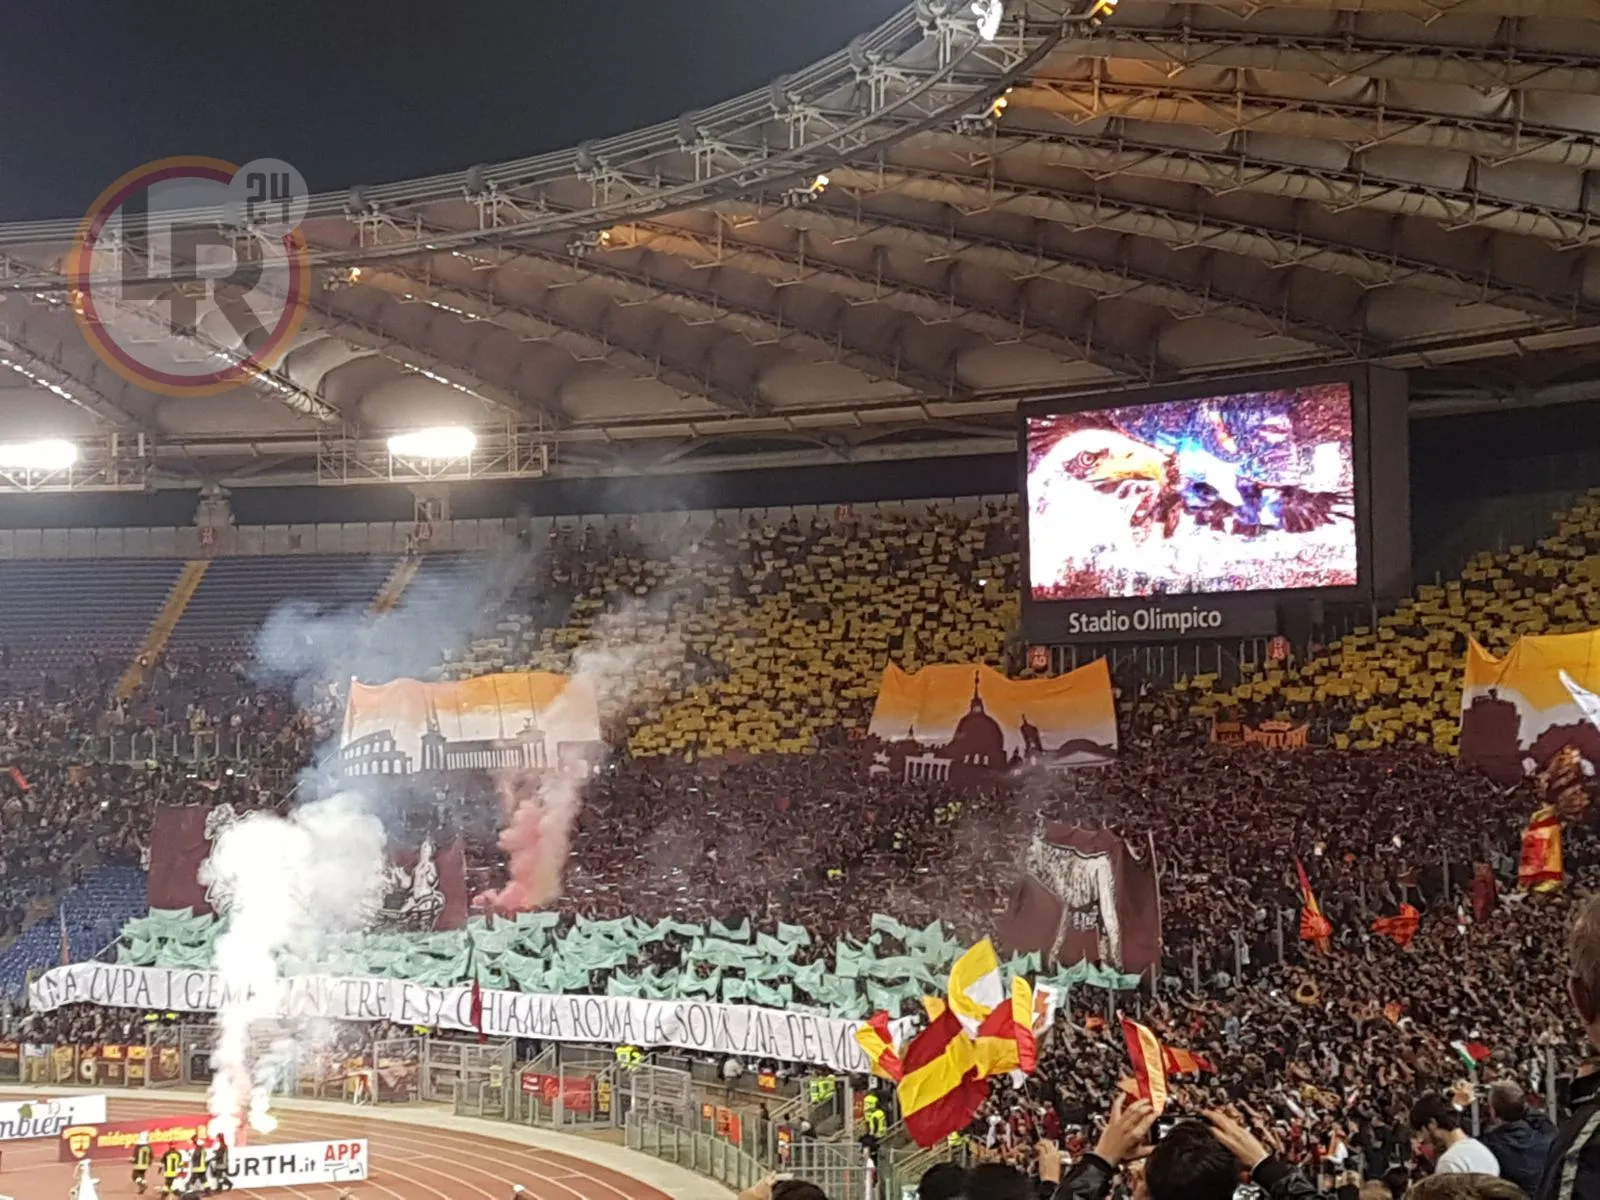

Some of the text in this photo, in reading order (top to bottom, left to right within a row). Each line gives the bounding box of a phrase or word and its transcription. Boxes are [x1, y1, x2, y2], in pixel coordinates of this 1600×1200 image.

[1069, 606, 1222, 634] Stadio Olimpico
[400, 983, 414, 1021] E
[456, 990, 564, 1036] CHIAMA
[570, 997, 637, 1042] ROMA
[643, 1004, 671, 1043] LA
[786, 1013, 830, 1063] DEL
[324, 1143, 361, 1162] APP
